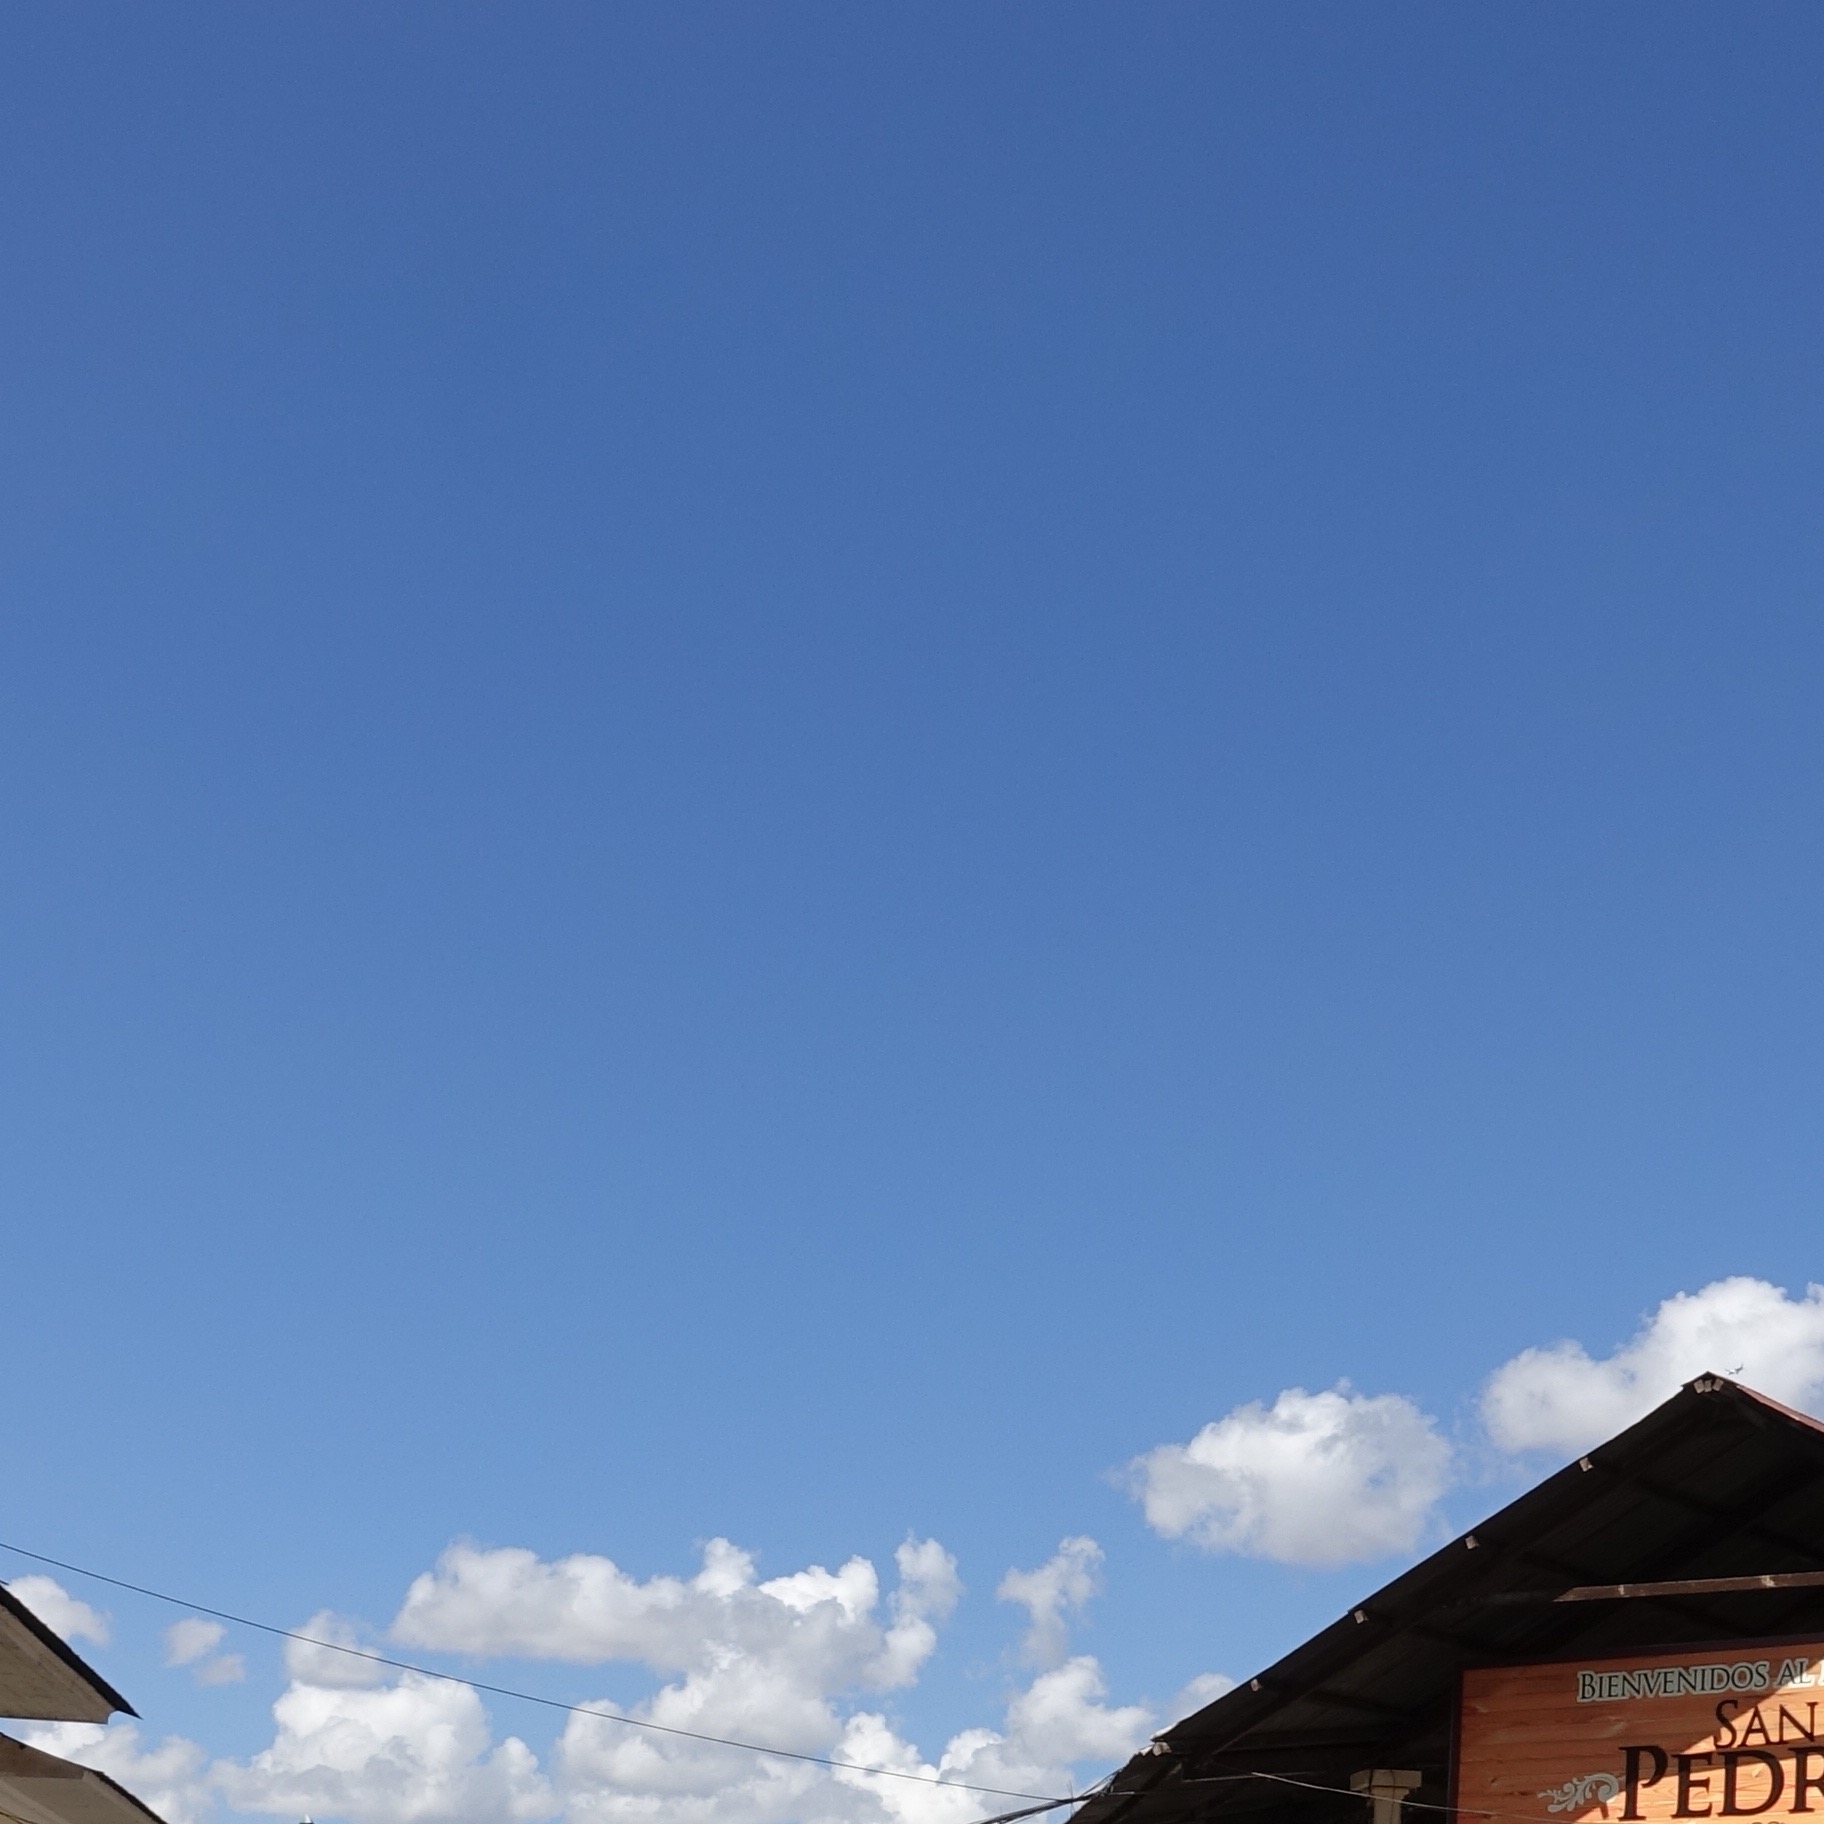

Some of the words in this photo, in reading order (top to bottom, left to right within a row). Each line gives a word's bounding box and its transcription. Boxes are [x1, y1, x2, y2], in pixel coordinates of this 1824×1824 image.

[1580, 1660, 1771, 1701] BIENVENIDOS
[1777, 1657, 1814, 1687] AL
[1714, 1699, 1819, 1749] SAN
